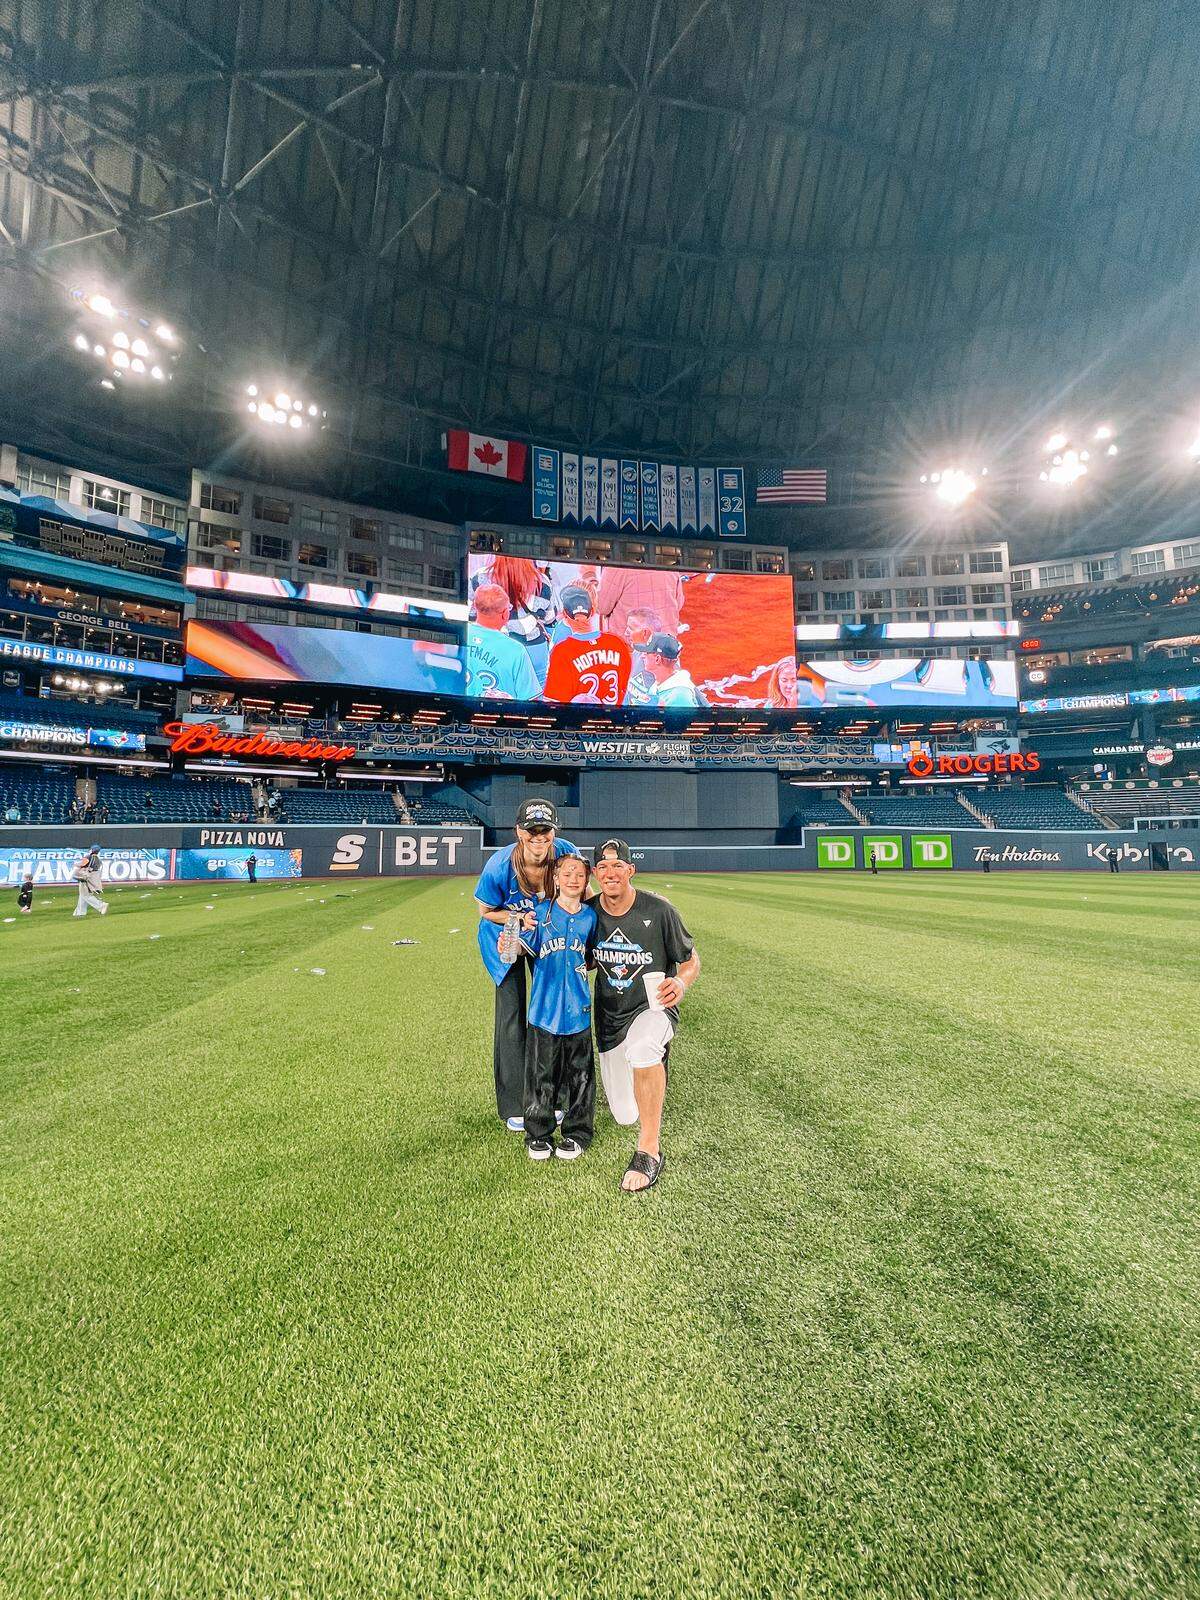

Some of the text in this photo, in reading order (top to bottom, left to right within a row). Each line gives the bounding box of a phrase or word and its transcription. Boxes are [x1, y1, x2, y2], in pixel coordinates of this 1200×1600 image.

[720, 496, 743, 512] 32
[57, 611, 131, 631] GEORGE BELL
[0, 643, 135, 673] EAGUE CHAMPIONS
[572, 649, 620, 673] HOFFMAN
[579, 669, 619, 705] 23
[1064, 696, 1126, 709] CHAMPIONS
[0, 726, 86, 745] CHAMPIONS
[163, 722, 356, 761] Budweiser
[582, 741, 690, 755] WESTJET FLIGHT
[1093, 745, 1144, 754] CANADA DRY
[939, 752, 1040, 774] ROGERS
[200, 829, 284, 846] PIZZA NOVA
[12, 851, 146, 860] AMERICA LEAGUE
[395, 836, 463, 866] BET
[631, 852, 645, 860] 400
[821, 842, 851, 862] TD
[867, 841, 898, 862] TD
[915, 840, 947, 861] TD
[207, 859, 275, 868] 20 25
[592, 948, 654, 966] CHAMPIONS
